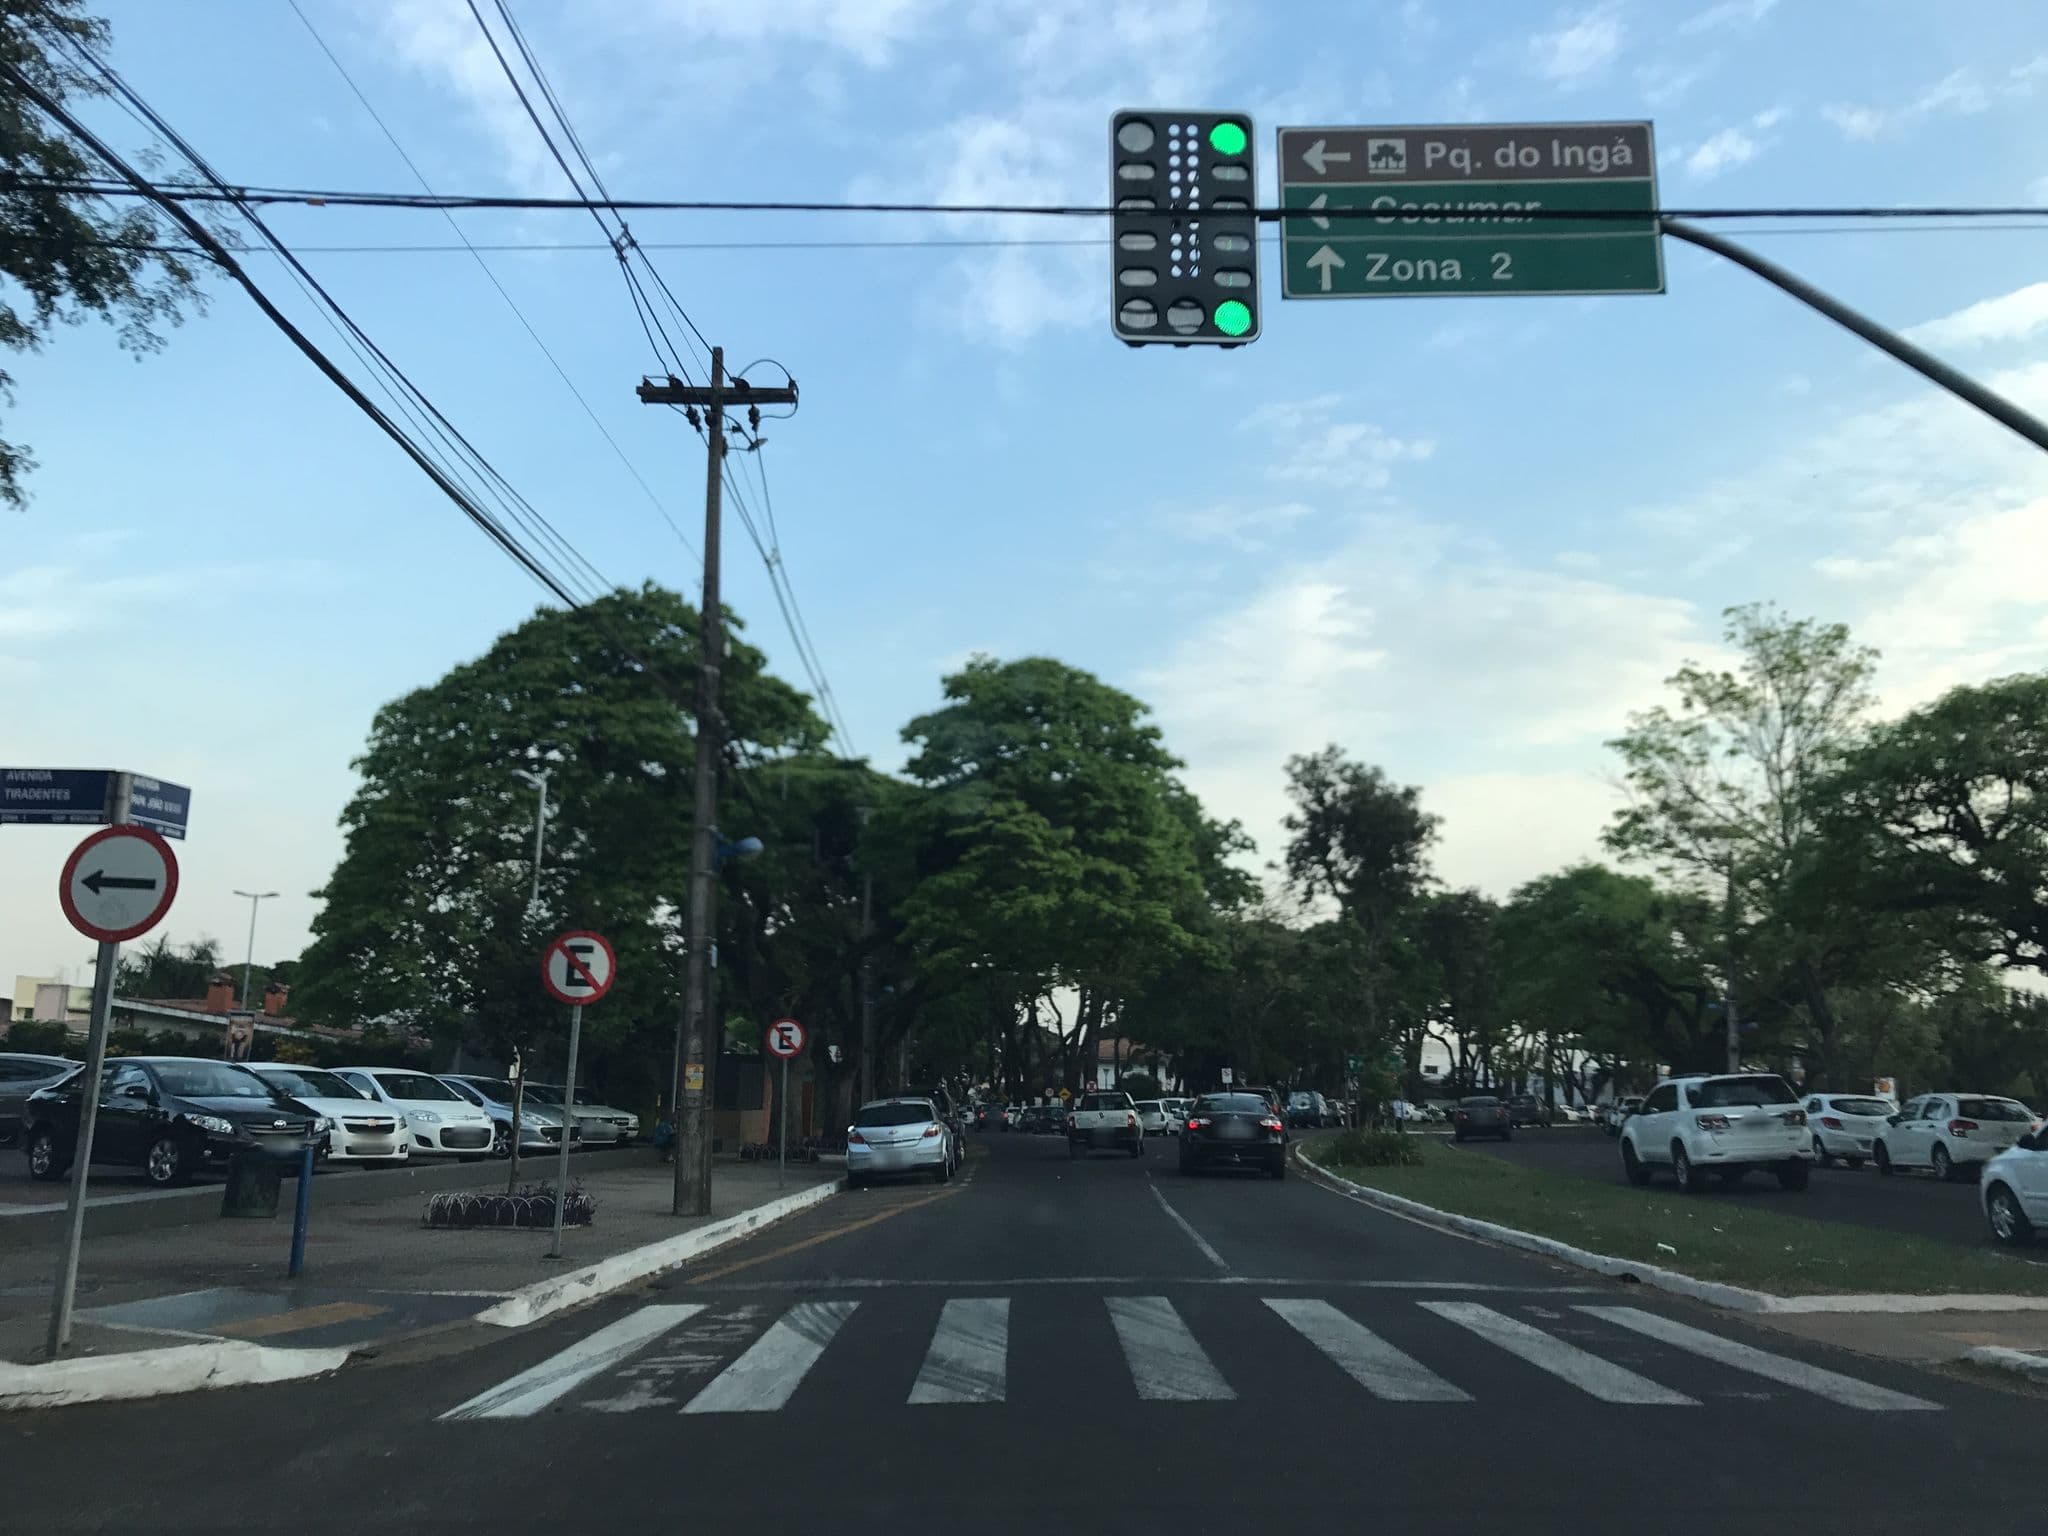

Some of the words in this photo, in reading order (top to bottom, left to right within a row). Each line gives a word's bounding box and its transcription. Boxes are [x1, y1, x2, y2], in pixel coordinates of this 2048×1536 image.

[1425, 141, 1482, 174] Pq.
[1494, 141, 1540, 168] do
[1552, 136, 1633, 173] Ingá
[1366, 253, 1462, 282] Zona
[1491, 252, 1513, 280] 2
[5, 788, 71, 801] TIRADENTES
[565, 945, 594, 987] E
[779, 1027, 794, 1049] E
